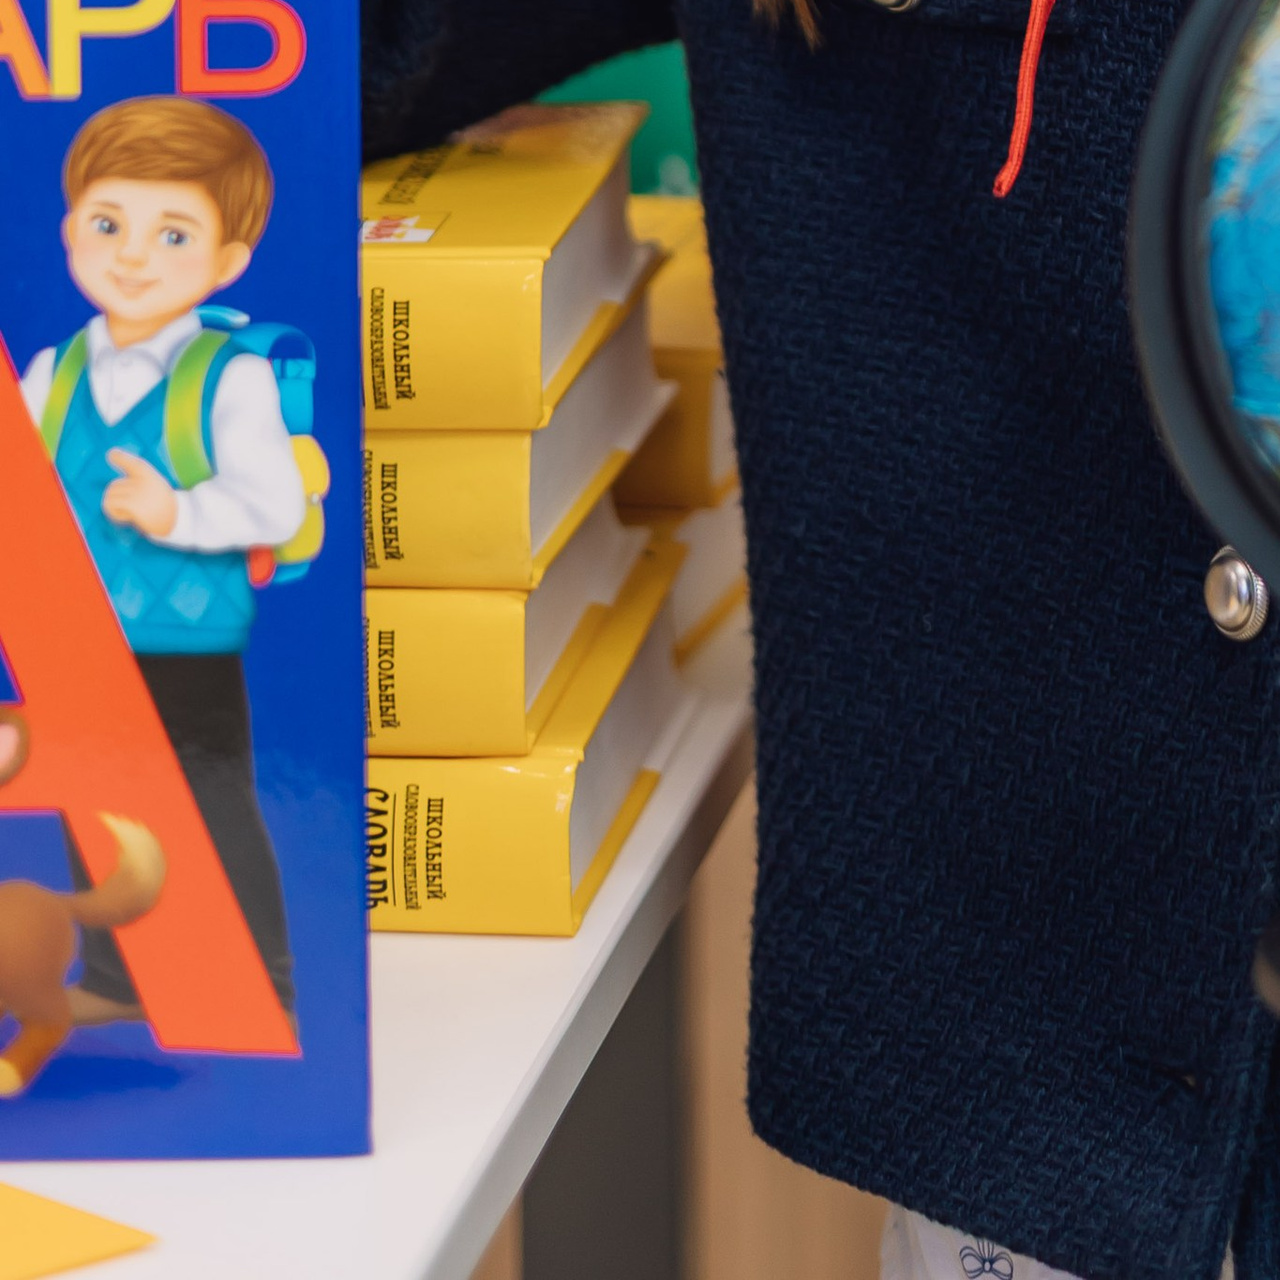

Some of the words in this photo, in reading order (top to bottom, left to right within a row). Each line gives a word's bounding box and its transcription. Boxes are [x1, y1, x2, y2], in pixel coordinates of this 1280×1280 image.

[393, 299, 416, 401] ШКОЛЬНЫЙ
[380, 462, 404, 561] ШКОЛЬНЫЙ
[378, 629, 401, 729] ШКОЛЬНЫЙ
[425, 797, 446, 900] ШКОЛЬНЫЙ
